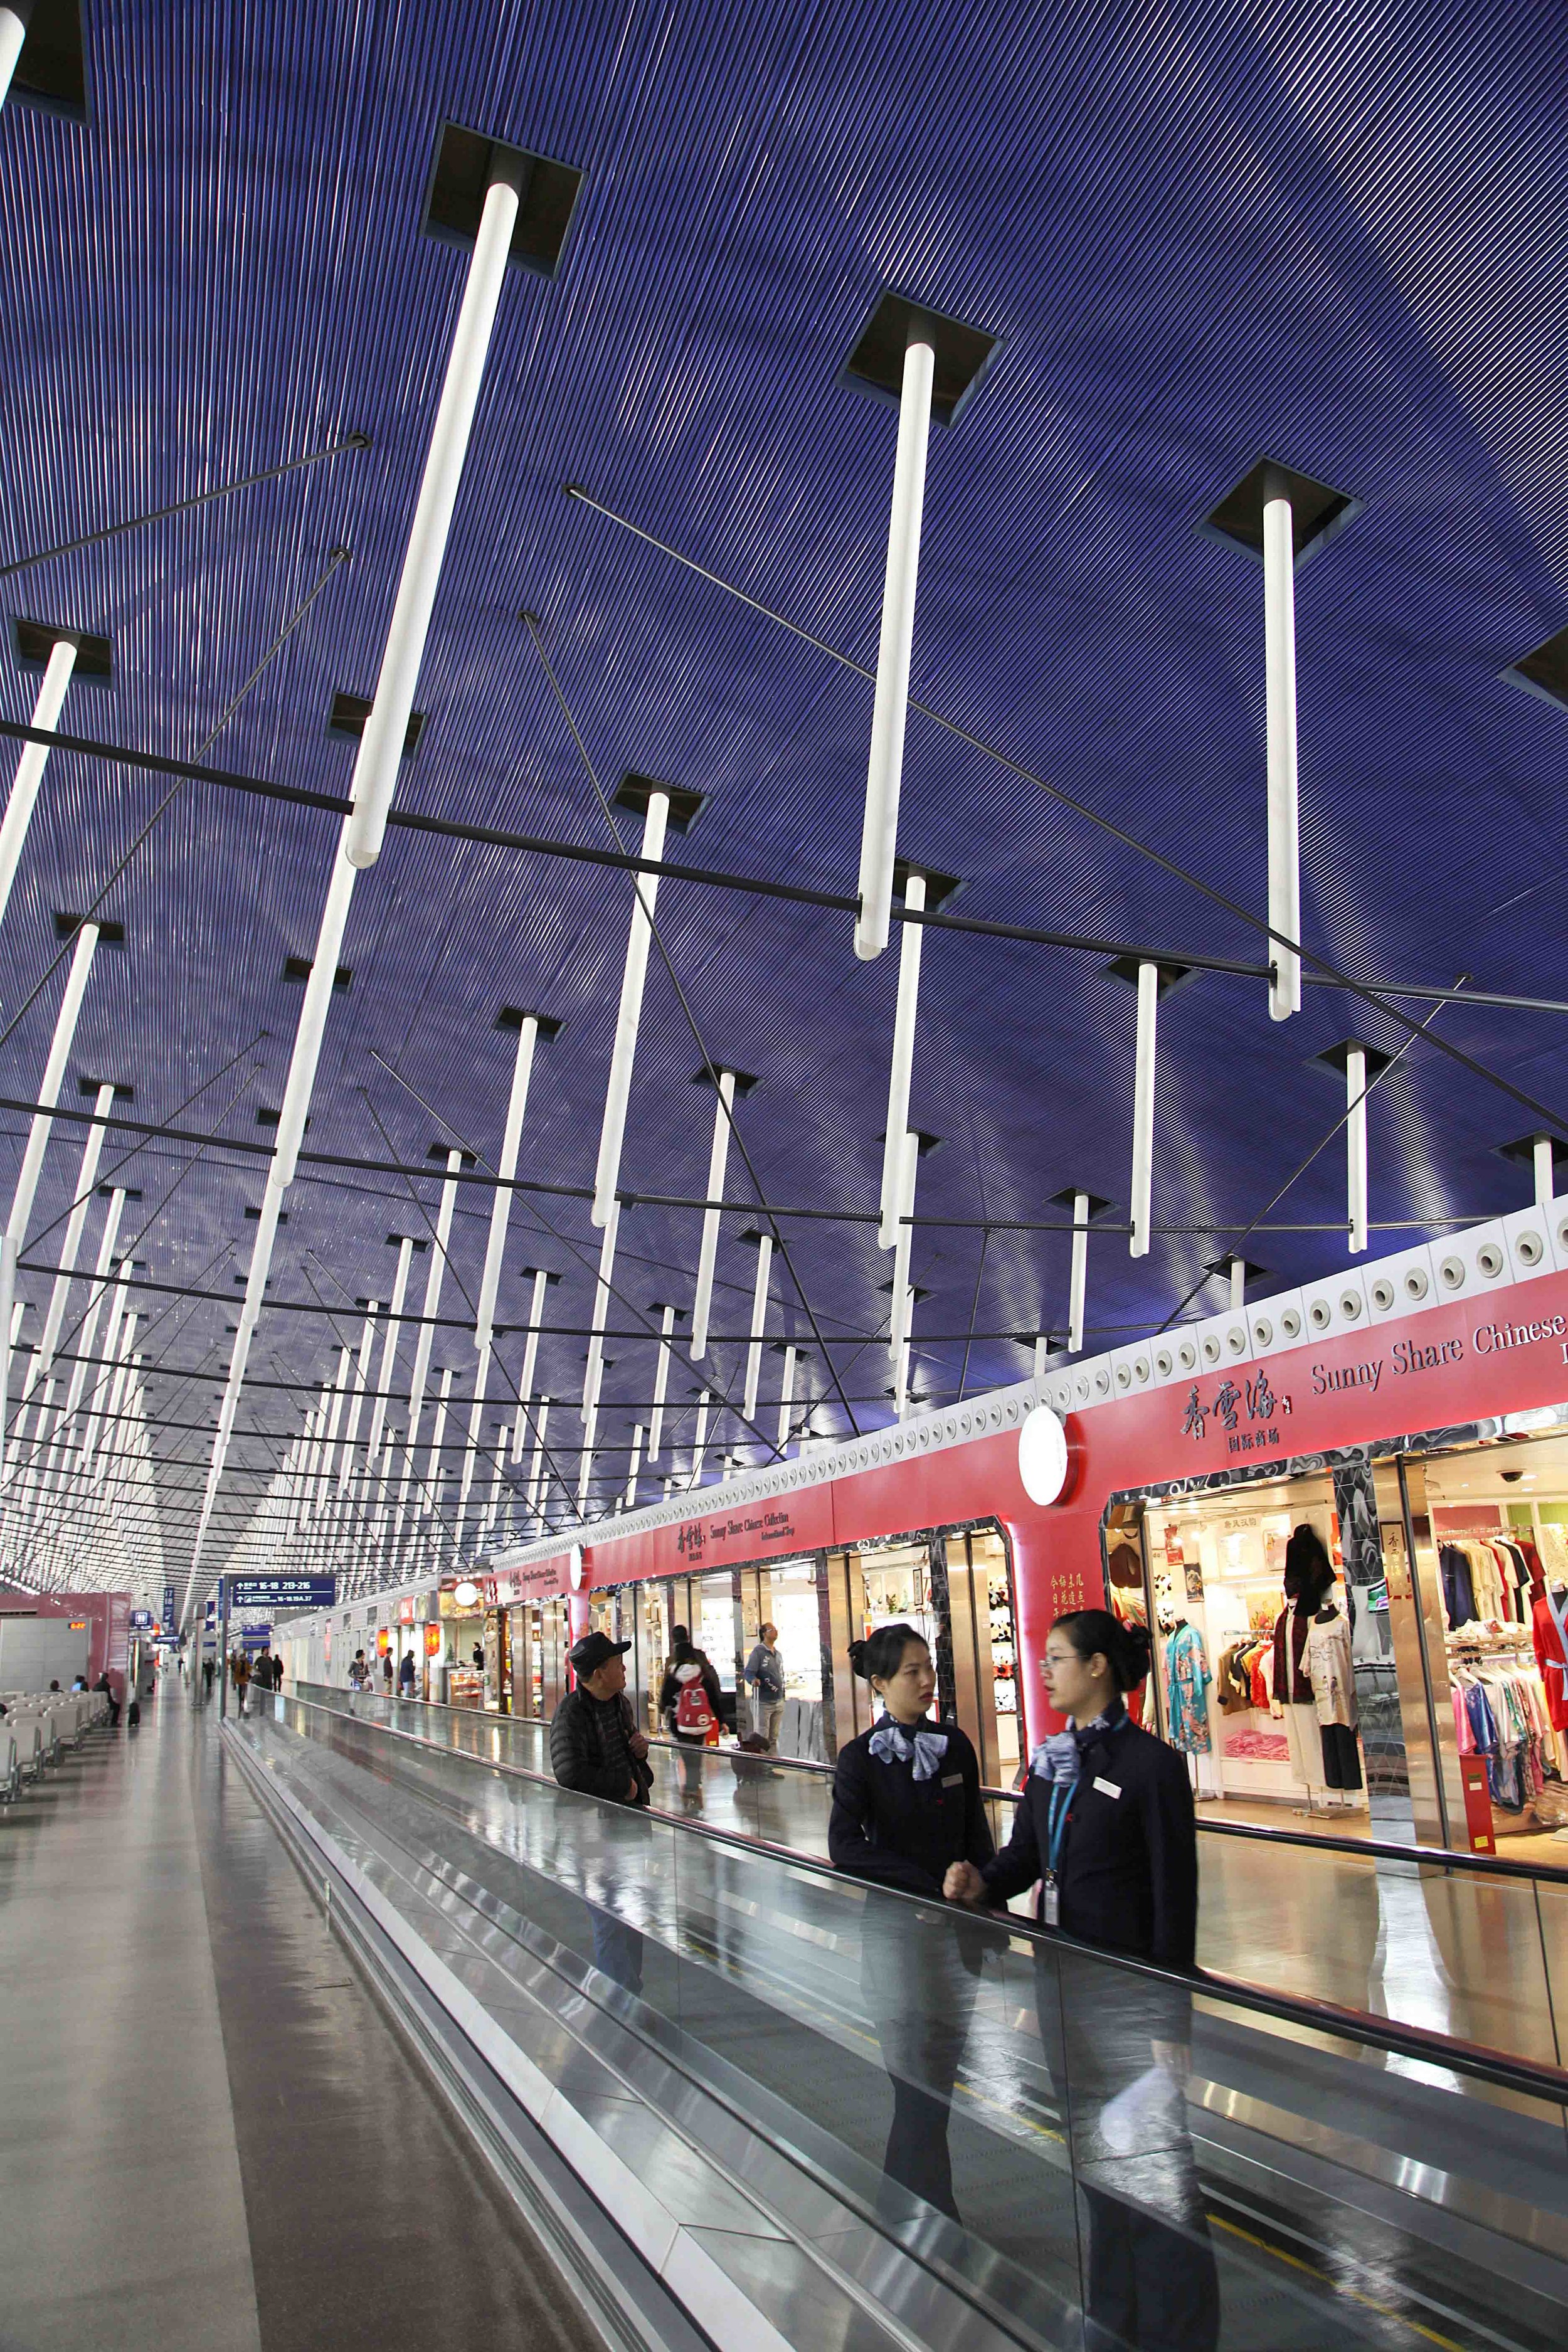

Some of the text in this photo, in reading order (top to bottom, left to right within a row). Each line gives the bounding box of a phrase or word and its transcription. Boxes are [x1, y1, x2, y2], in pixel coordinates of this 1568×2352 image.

[1311, 1315, 1567, 1395] Sunny Share Chinese
[1180, 1369, 1277, 1441] 香雪海
[1228, 1428, 1279, 1453] 国际商场
[282, 1582, 310, 1590] 213-216
